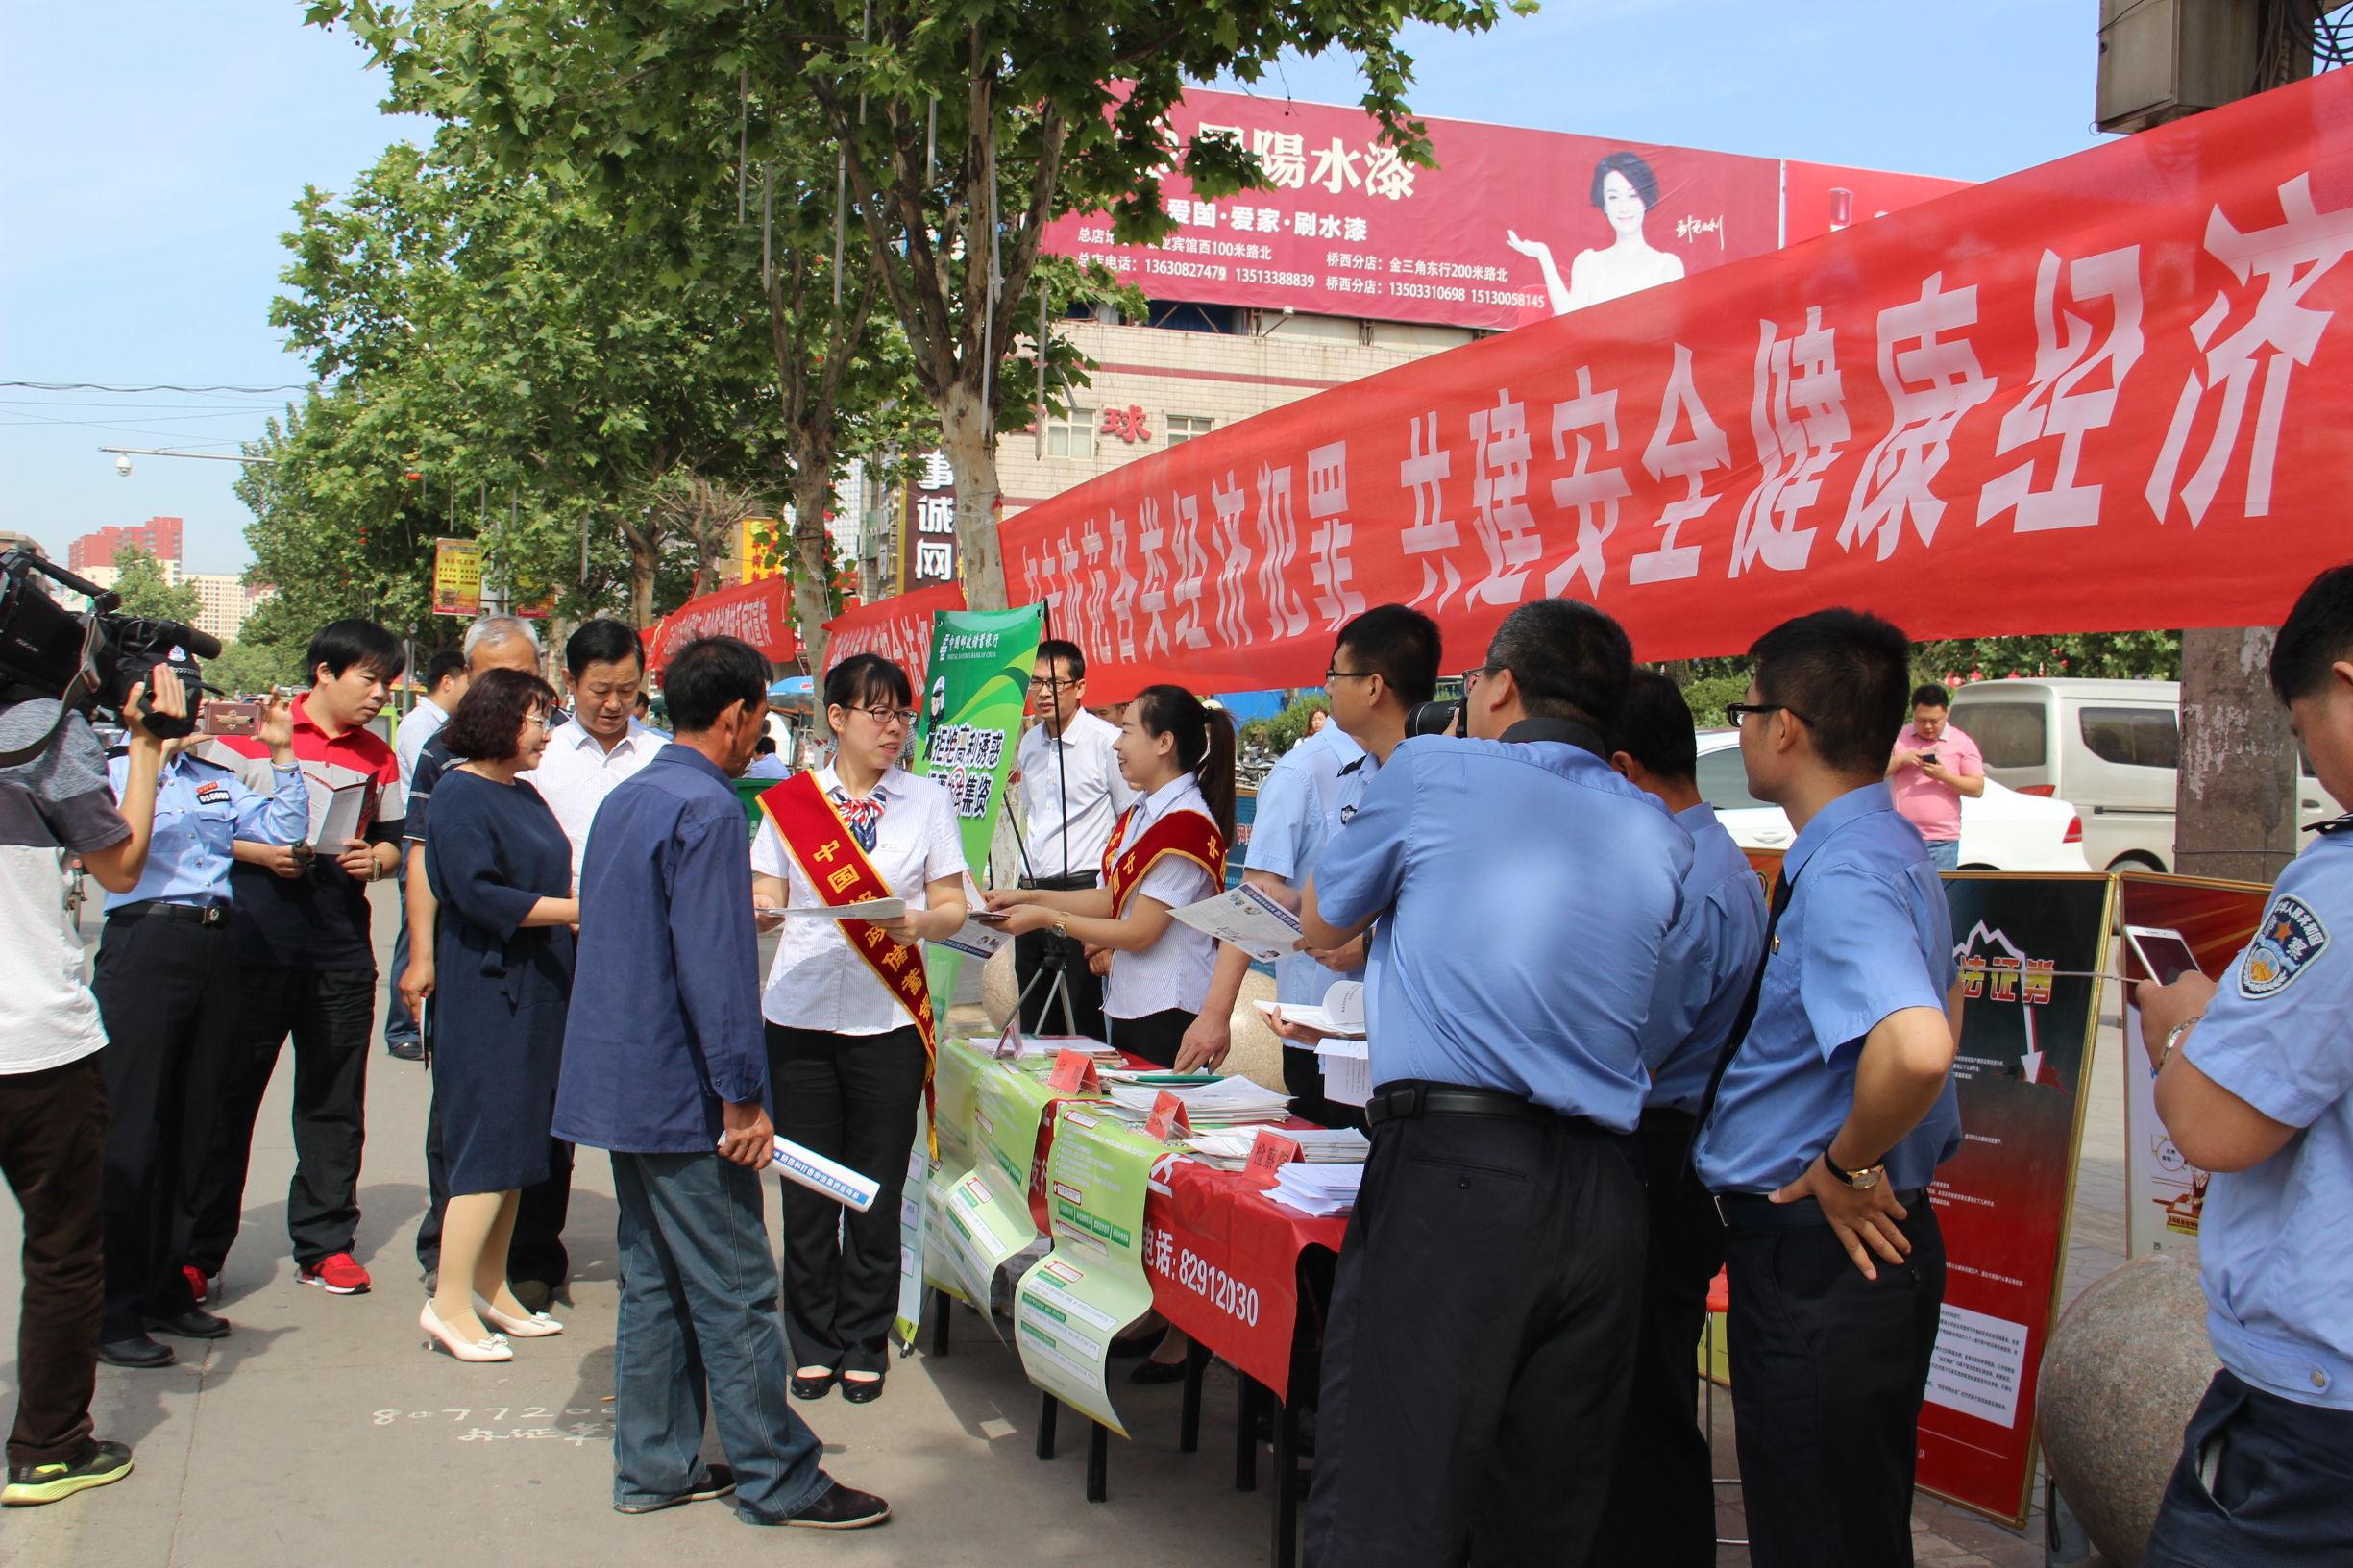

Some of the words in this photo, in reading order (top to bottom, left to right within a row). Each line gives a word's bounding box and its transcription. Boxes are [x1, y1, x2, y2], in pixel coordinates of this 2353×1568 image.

[1167, 199, 1367, 242] 爱国·爱家·刷水漆
[1236, 268, 1314, 287] 13513388839
[1471, 289, 1544, 307] 15130058145
[949, 633, 999, 650] 中国邮政储蓄银行
